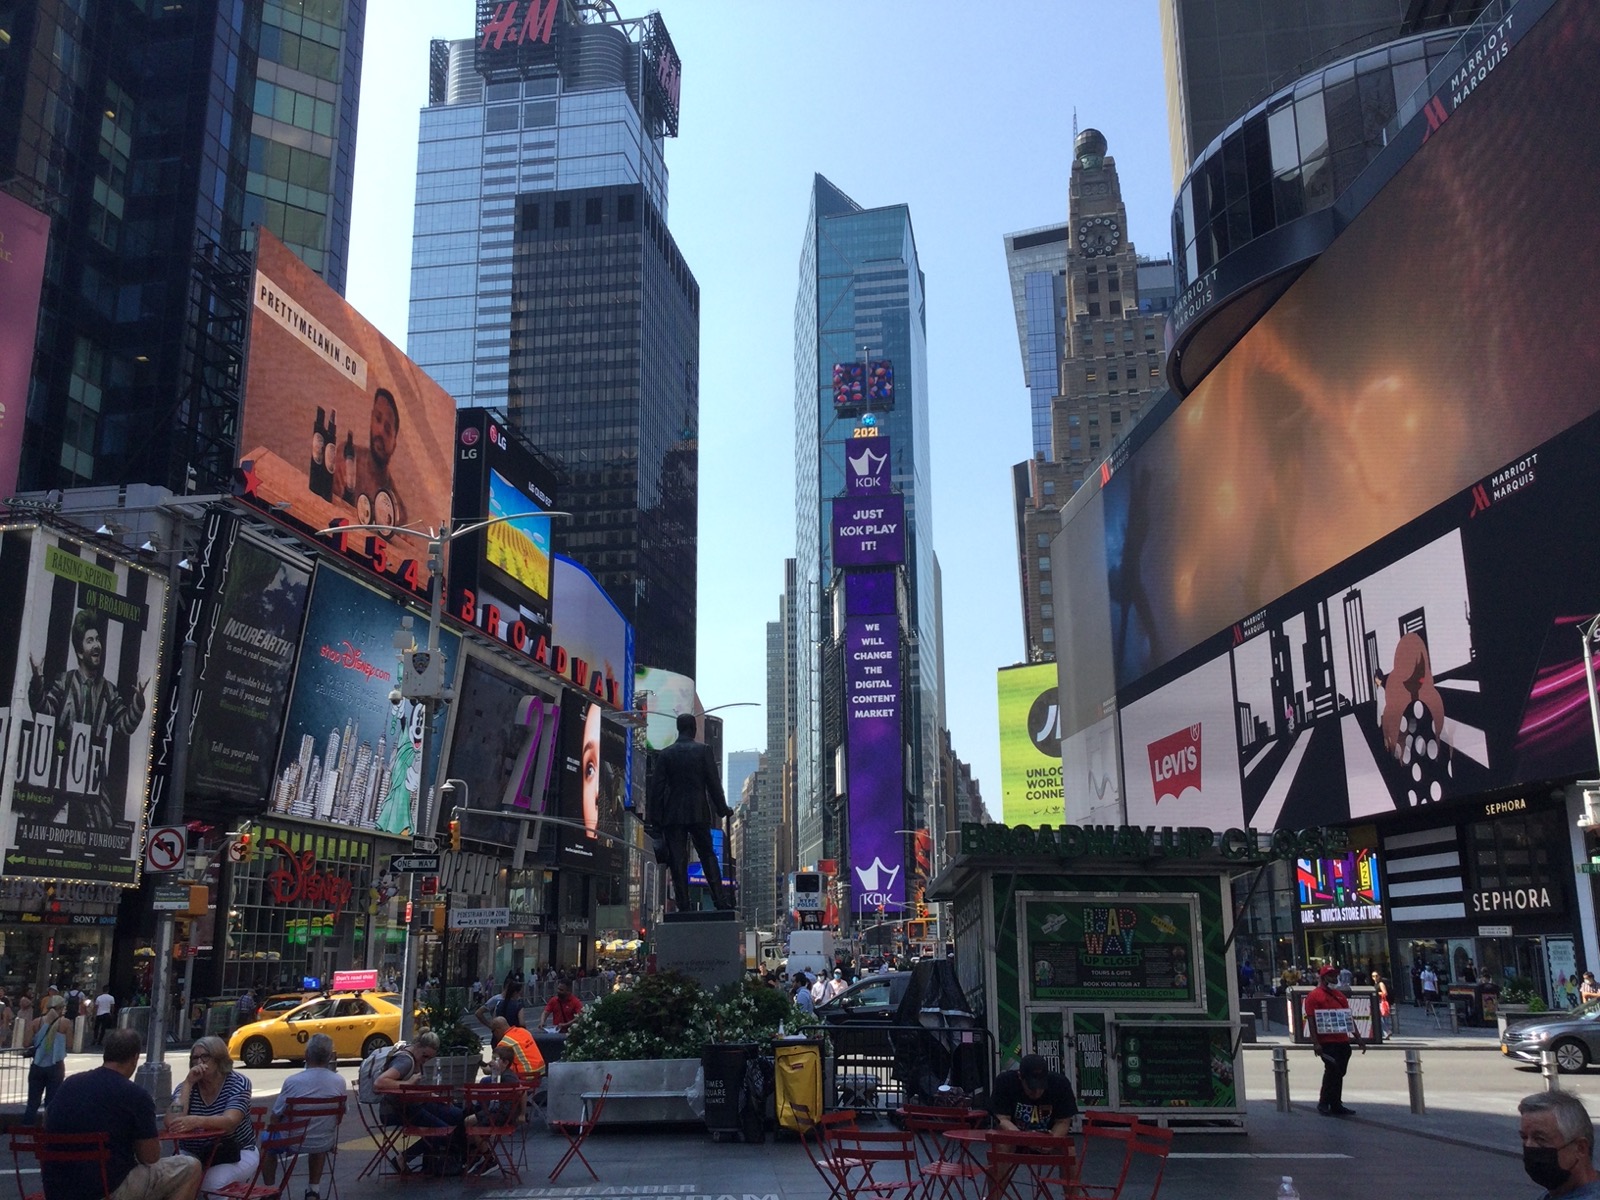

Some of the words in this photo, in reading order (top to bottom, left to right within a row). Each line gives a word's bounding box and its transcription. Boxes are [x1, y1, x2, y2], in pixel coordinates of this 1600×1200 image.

[481, 0, 558, 50] H&M
[1451, 14, 1513, 91] MARRIOTT
[1453, 42, 1508, 108] MARQUIS
[1174, 268, 1218, 316] MARRIOTT
[1175, 290, 1212, 333] MARQUIS
[260, 285, 357, 375] PRETTYMELANIN.CO
[853, 427, 878, 438] 2021
[498, 432, 507, 450] LG
[461, 448, 477, 459] LG
[1492, 453, 1538, 487] MARRIOTT
[856, 477, 881, 487] KOK
[1494, 471, 1534, 500] MARQUIS
[8, 498, 57, 509] LAMAR
[853, 509, 884, 520] JUST
[840, 526, 864, 536] KOK
[866, 524, 898, 535] PLAY
[861, 541, 877, 551] IT!
[52, 552, 83, 578] RAISING
[84, 566, 112, 590] SPIRITS
[86, 589, 97, 606] ON
[99, 593, 140, 622] BROADWAY!
[460, 588, 621, 712] BROADWAY
[861, 638, 884, 646] WILL
[854, 651, 892, 660] CHANGE
[864, 666, 882, 674] THE
[855, 680, 892, 689] DIGITAL
[852, 695, 896, 704] CONTENT
[855, 709, 895, 718] MARKET
[211, 740, 223, 753] Tell
[245, 751, 259, 762] plan
[1027, 778, 1064, 790] WORL
[1485, 798, 1527, 815] SEPHORA
[29, 825, 86, 845] JAW-DROPPING
[961, 821, 1156, 858] BROADWAY
[1161, 826, 1214, 858] UP
[396, 858, 412, 869] ONE
[418, 858, 434, 869] WAY
[56, 882, 123, 904] LUGGAGE
[863, 893, 892, 905] KOK
[1472, 887, 1551, 912] SEPHORA
[73, 915, 97, 924] SONY
[1342, 907, 1359, 921] STORE
[1360, 906, 1368, 920] AT
[1085, 955, 1099, 966] UP
[1102, 956, 1139, 967] CLOSE
[1077, 1033, 1101, 1051] PRIVATE
[1083, 1050, 1103, 1068] GROUP
[1081, 1089, 1105, 1098] AVAILABLE
